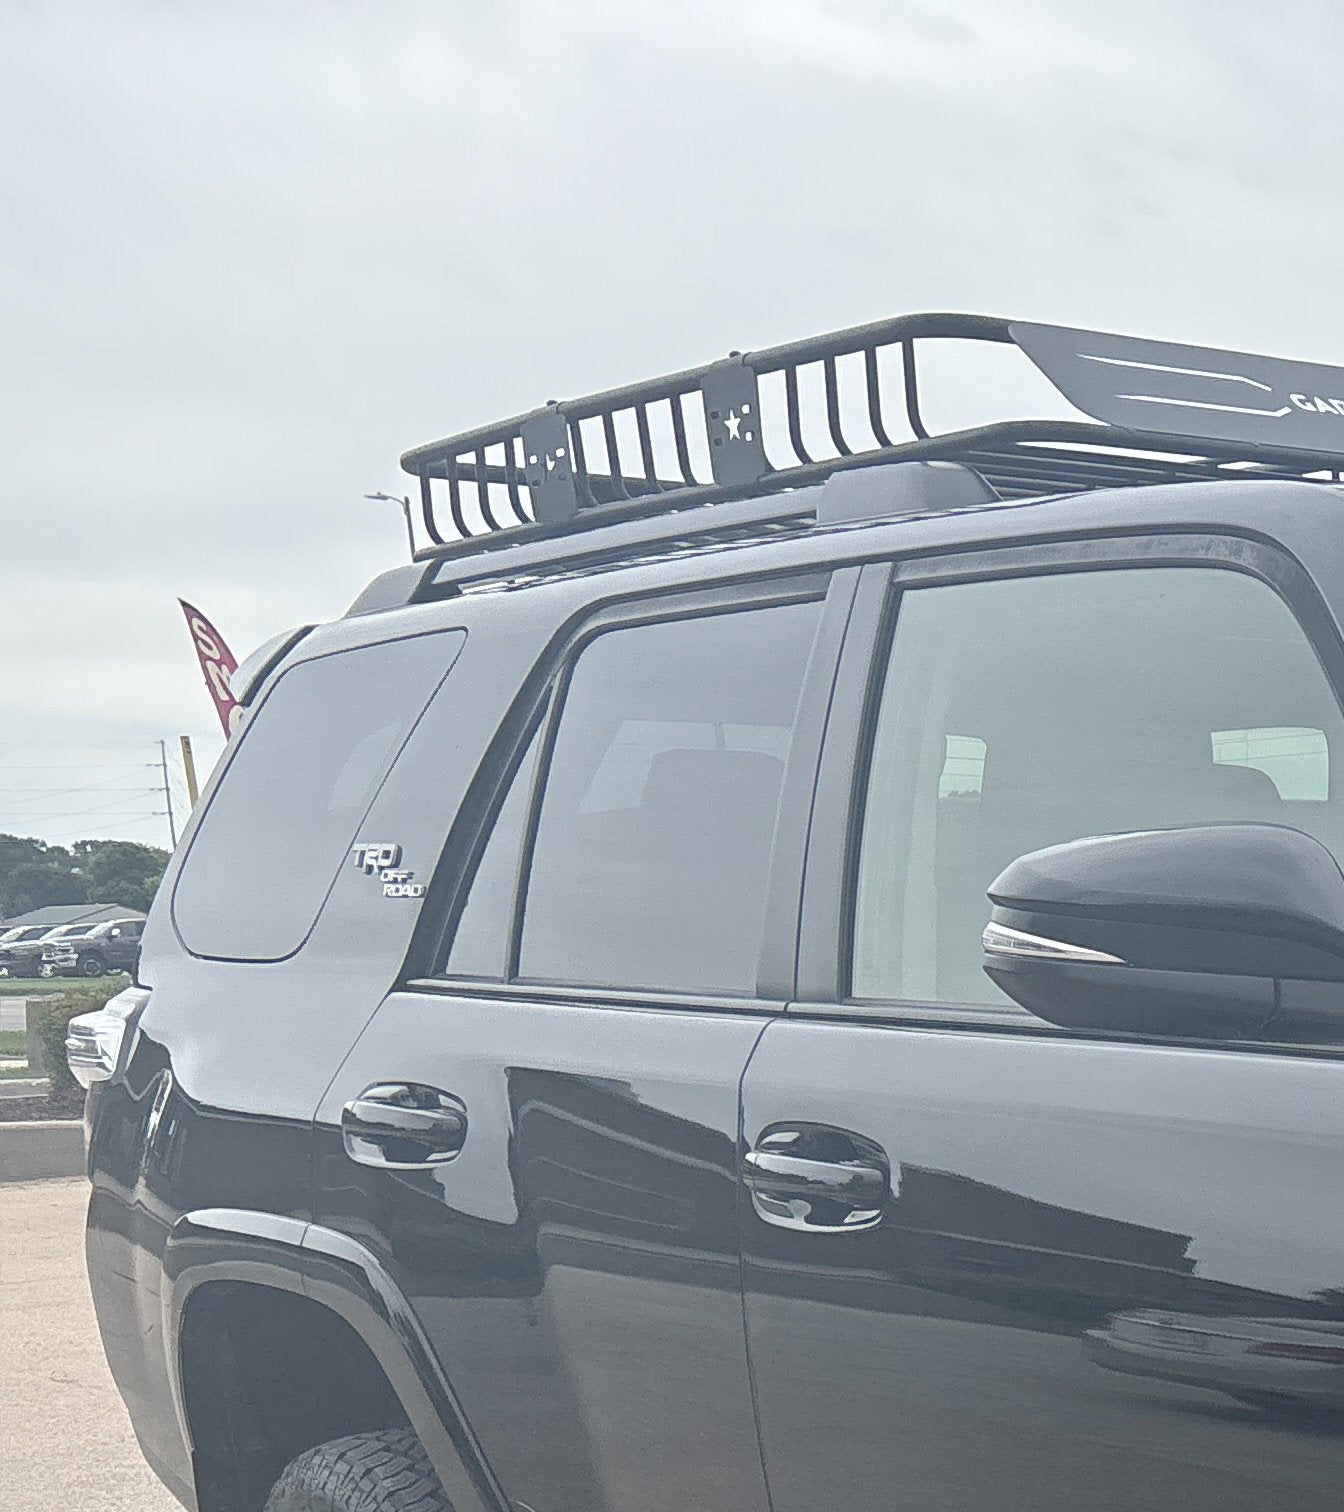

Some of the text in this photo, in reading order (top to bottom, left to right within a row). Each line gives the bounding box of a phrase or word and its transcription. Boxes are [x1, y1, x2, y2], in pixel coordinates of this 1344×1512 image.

[352, 843, 402, 875] TRD
[380, 869, 414, 883] OFF
[383, 883, 426, 898] ROAD
